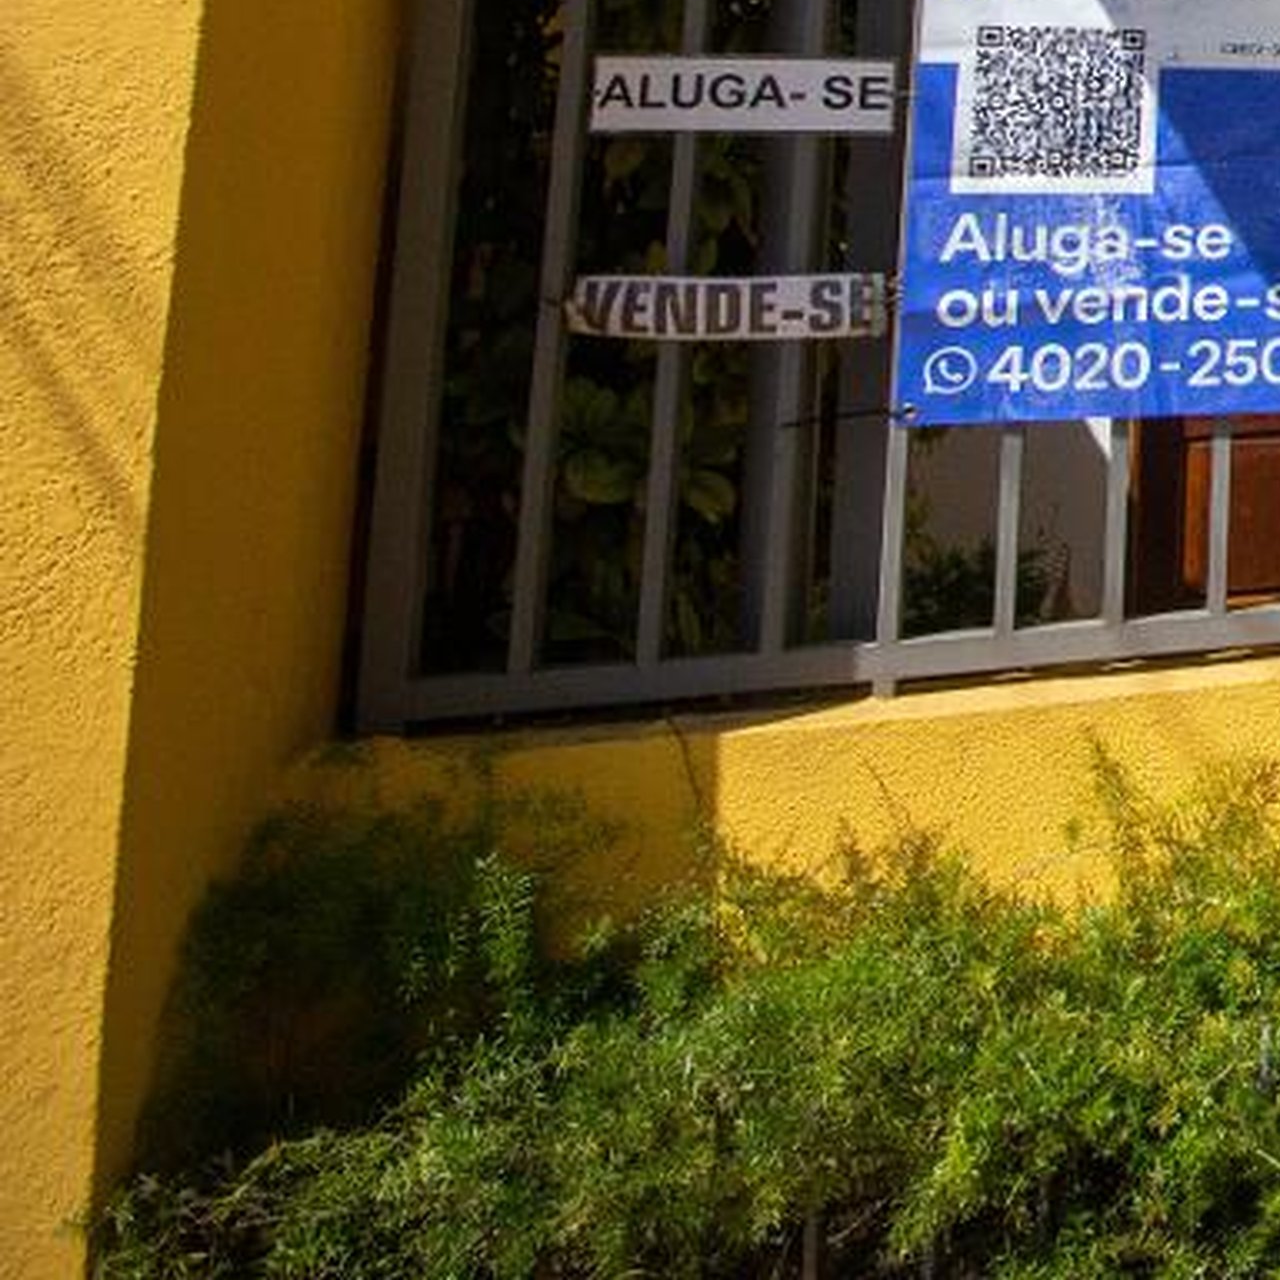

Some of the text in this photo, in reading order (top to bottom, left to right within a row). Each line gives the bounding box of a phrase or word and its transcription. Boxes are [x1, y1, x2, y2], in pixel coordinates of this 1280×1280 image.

[822, 75, 892, 111] SE
[938, 212, 1233, 276] Aluga-se
[935, 287, 1019, 329] ou
